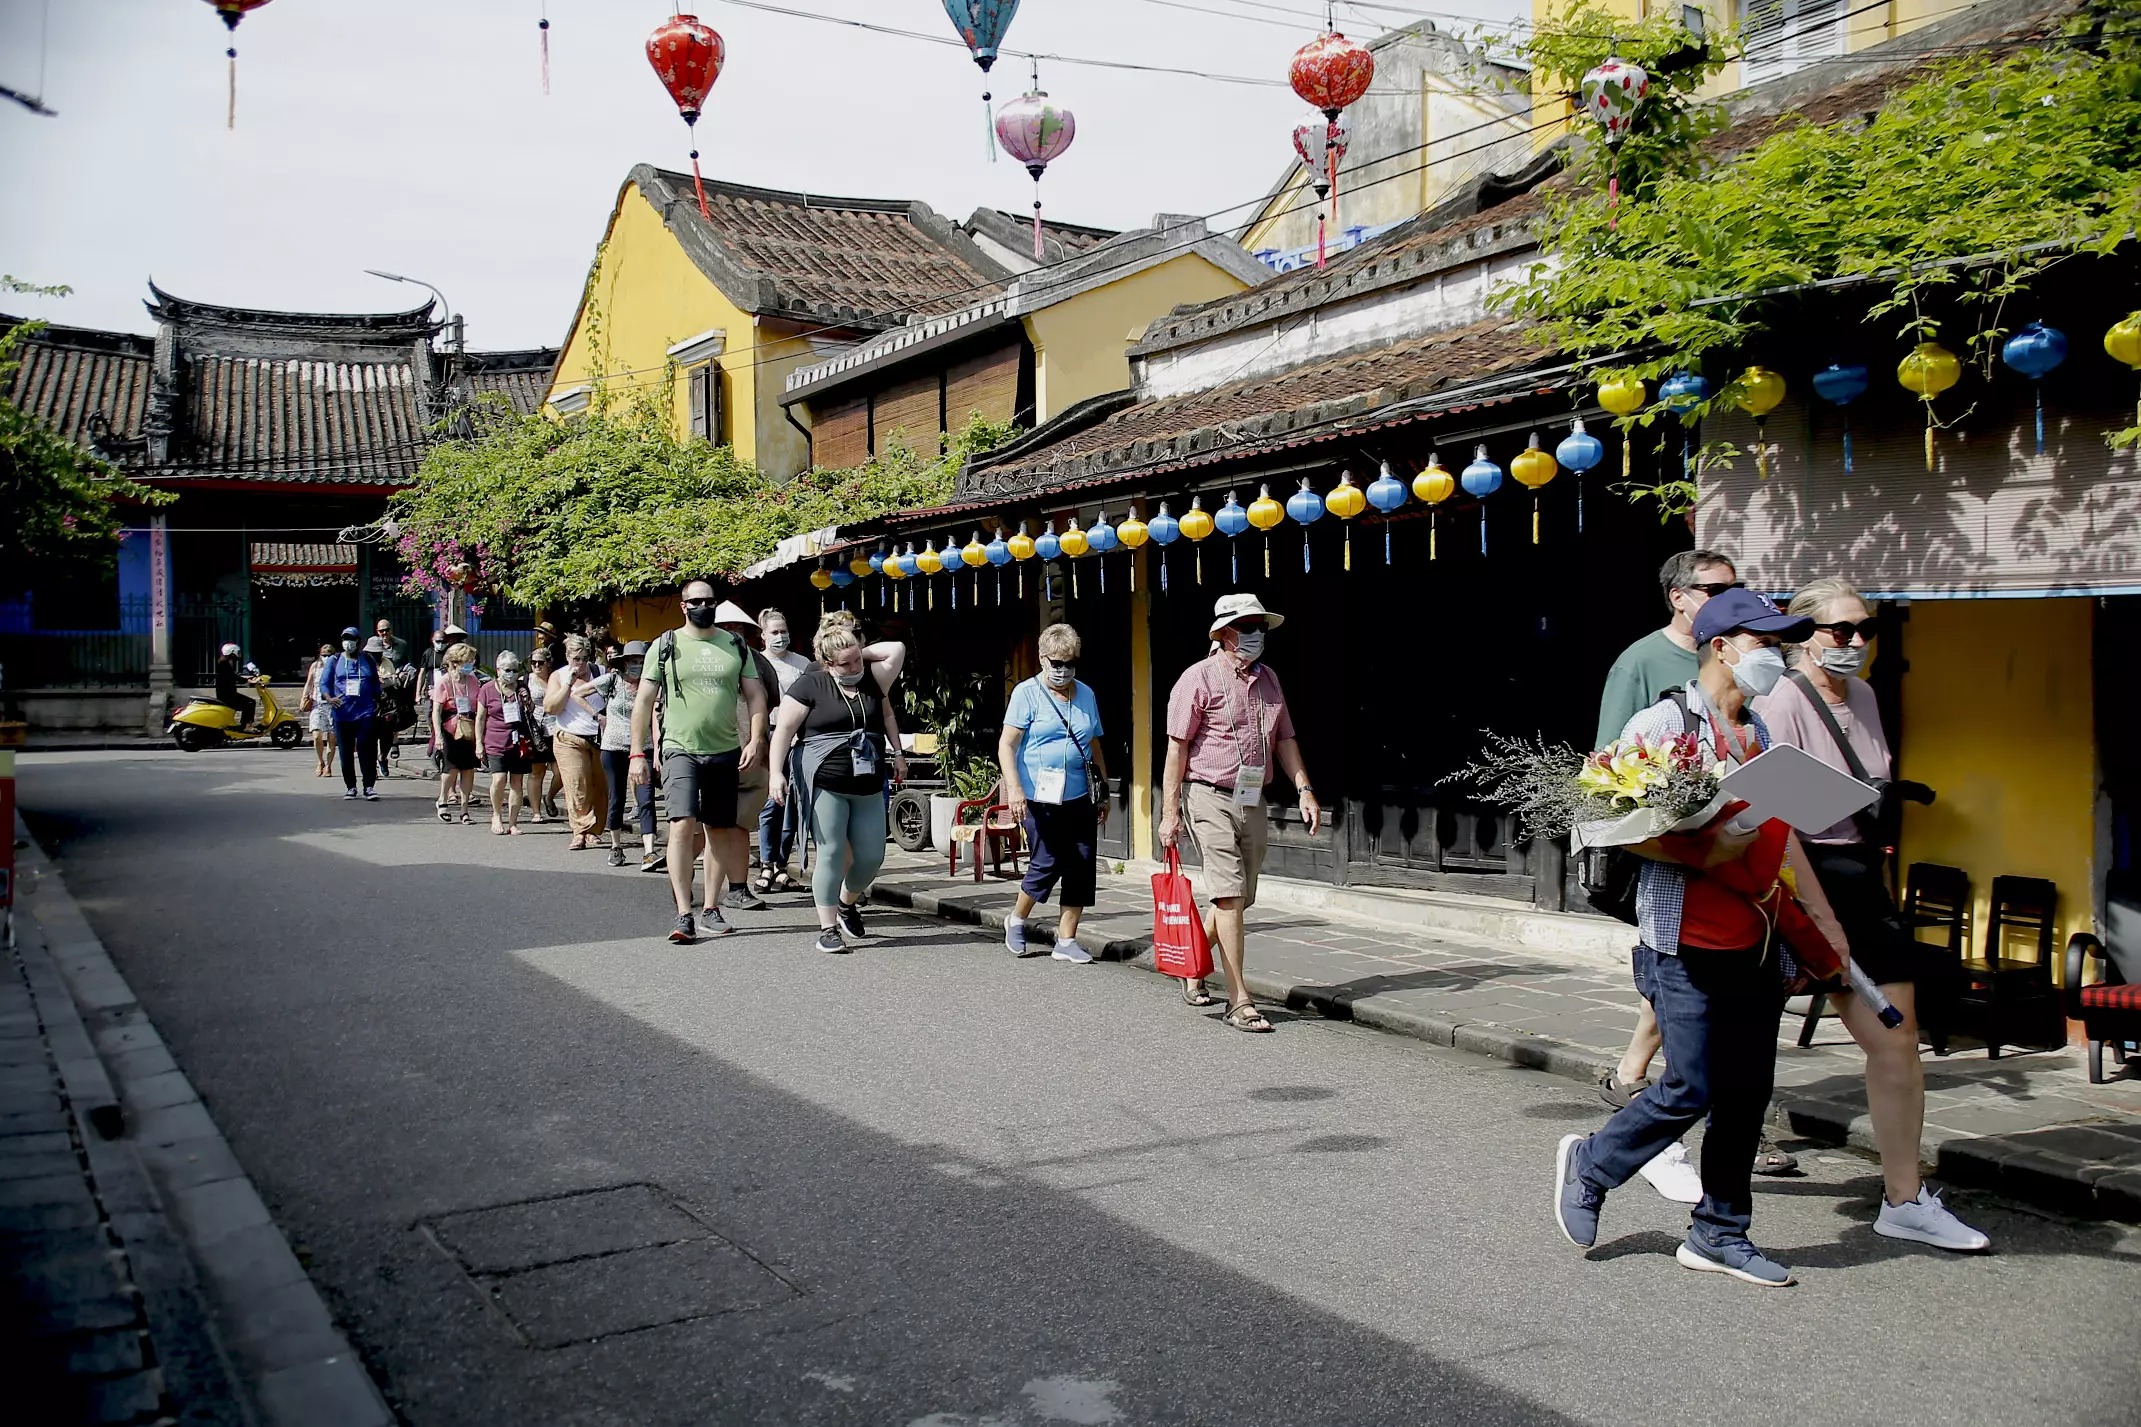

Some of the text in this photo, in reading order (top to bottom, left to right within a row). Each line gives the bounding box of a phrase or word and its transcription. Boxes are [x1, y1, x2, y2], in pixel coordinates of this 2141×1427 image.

[695, 656, 721, 664] KEEP
[692, 664, 724, 672] CALM
[702, 686, 718, 695] ON
